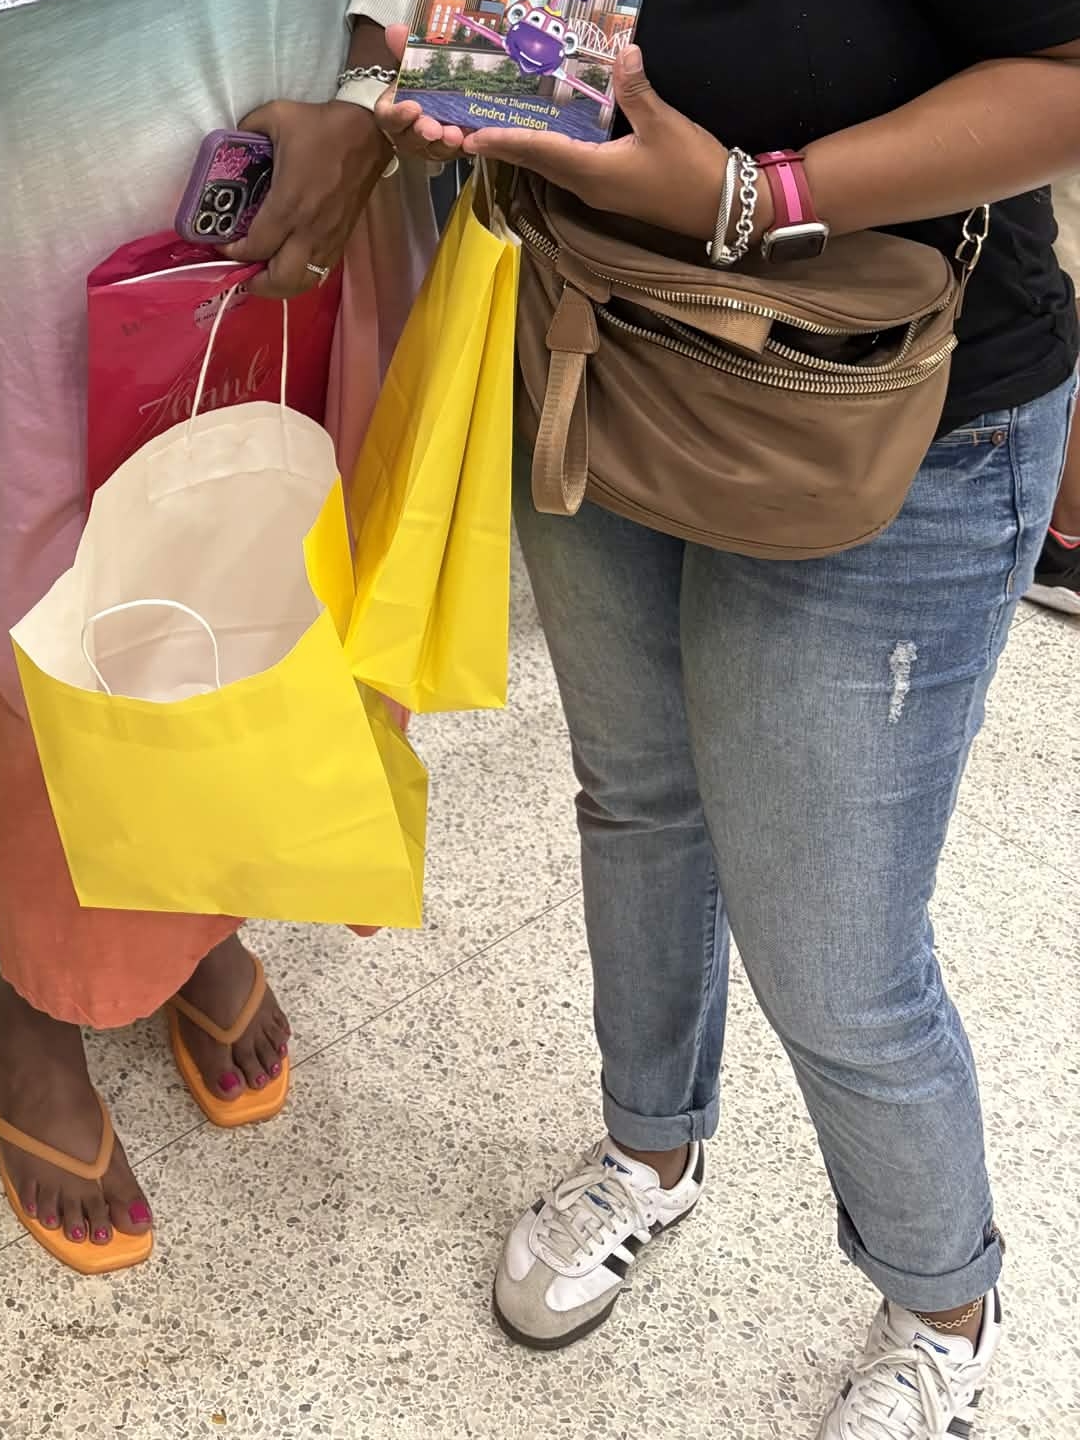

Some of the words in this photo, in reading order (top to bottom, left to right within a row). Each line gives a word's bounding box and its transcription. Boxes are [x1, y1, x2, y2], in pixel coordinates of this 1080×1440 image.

[464, 88, 493, 102] Written
[494, 96, 508, 106] and
[509, 97, 549, 114] Illustrated
[550, 106, 561, 119] By
[468, 103, 506, 122] Kendra
[507, 111, 549, 131] Hudson
